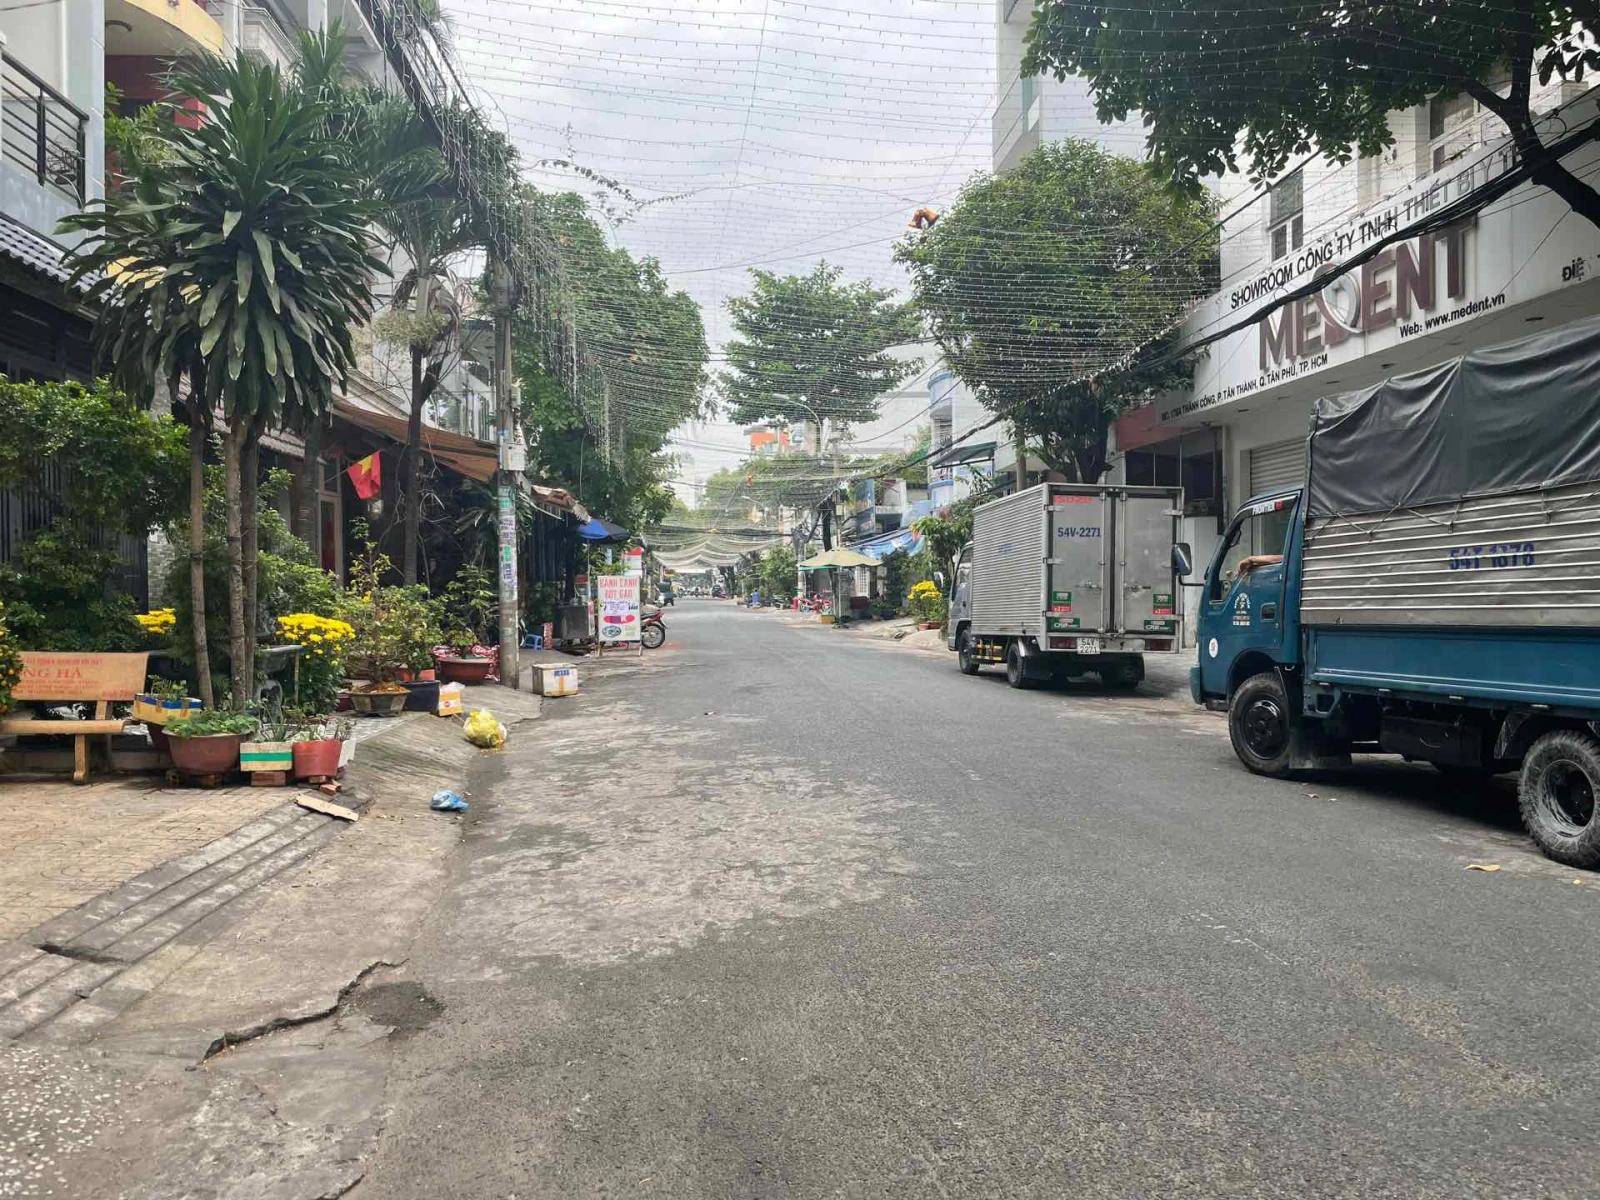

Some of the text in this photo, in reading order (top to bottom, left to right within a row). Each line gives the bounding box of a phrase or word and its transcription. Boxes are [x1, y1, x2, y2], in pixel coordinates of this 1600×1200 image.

[1231, 263, 1293, 309] SHOWROOM
[1297, 241, 1333, 275] CÔNG
[1337, 229, 1355, 255] TY
[1359, 206, 1398, 244] TNHH
[1260, 213, 1477, 370] MEDENT
[1400, 293, 1506, 338] Web: www.medent.vn
[1260, 376, 1267, 387] Q.
[1267, 370, 1280, 384] TÂN
[1300, 359, 1309, 373] TP.
[1311, 354, 1328, 370] HCM
[1058, 527, 1101, 538] 54V-2271
